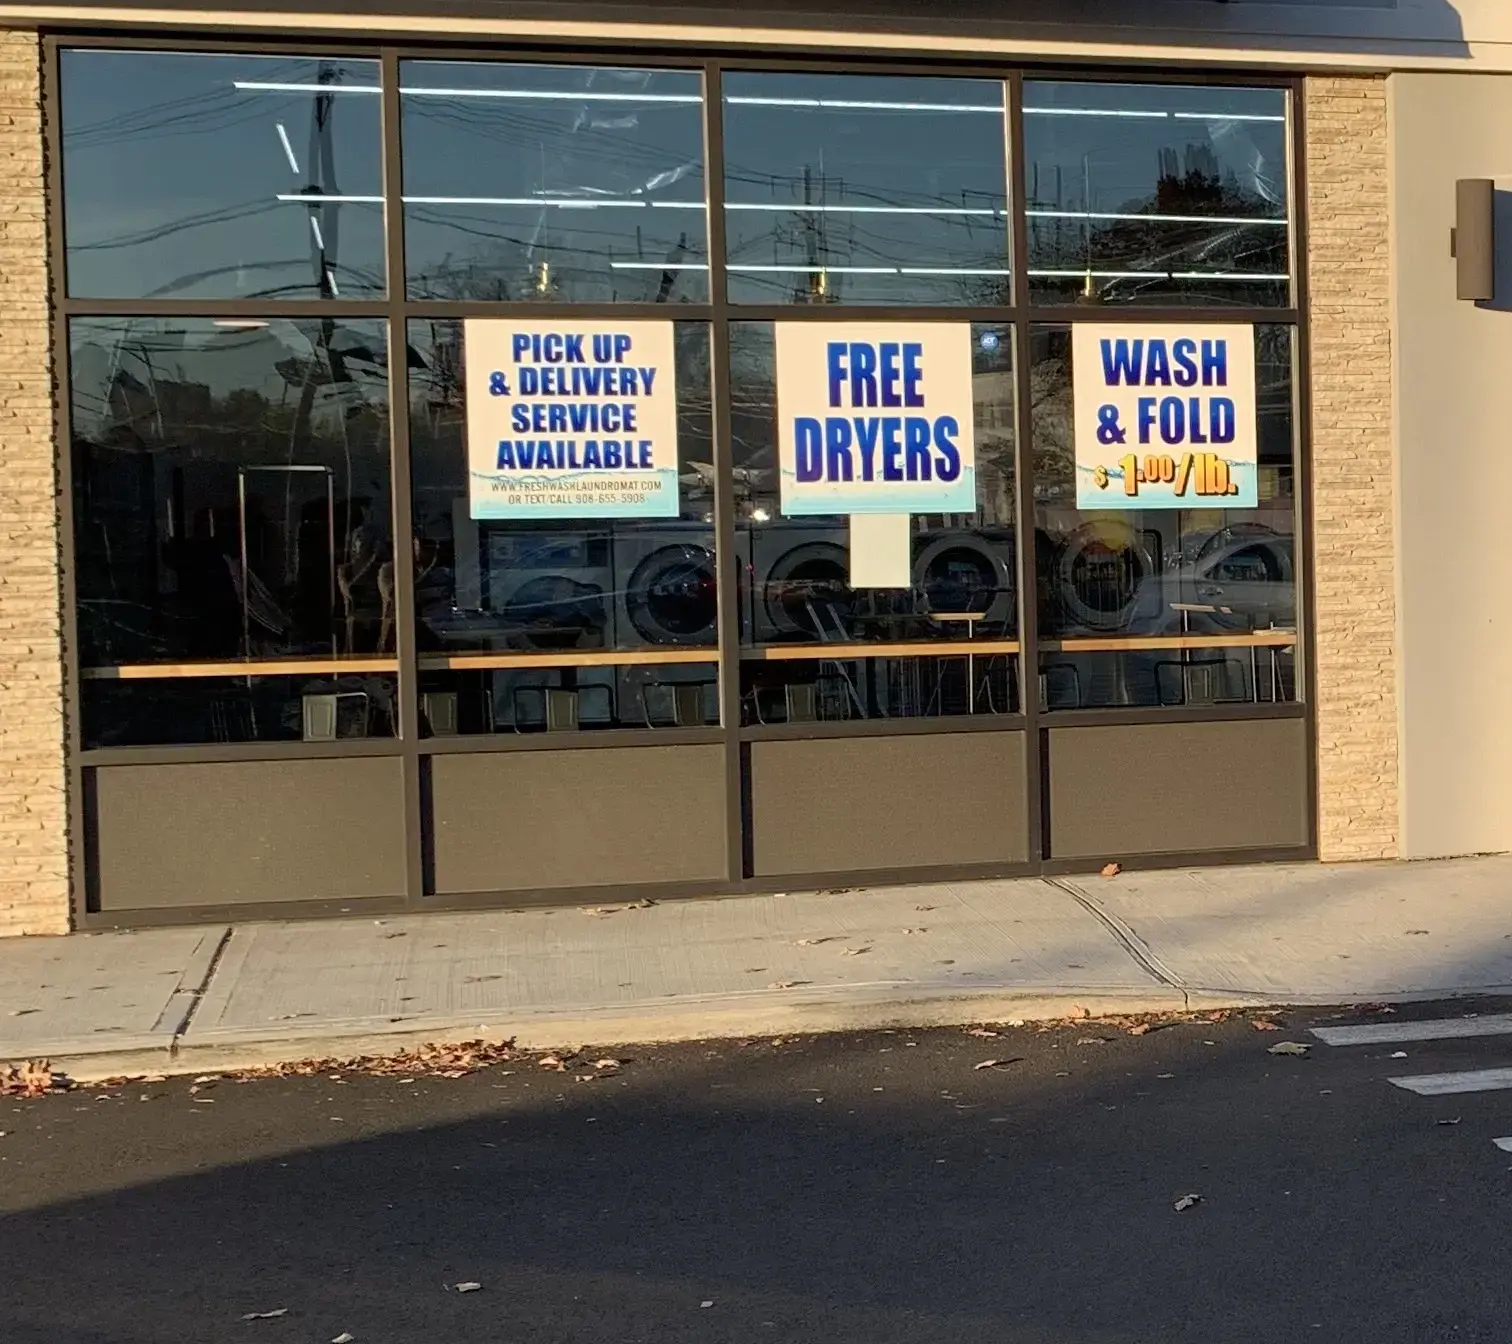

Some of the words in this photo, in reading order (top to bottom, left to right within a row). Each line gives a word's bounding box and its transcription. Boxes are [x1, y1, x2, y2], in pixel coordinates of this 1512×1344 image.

[512, 333, 585, 363] PICK
[593, 333, 632, 363] UP
[1100, 338, 1228, 387] WASH
[489, 371, 511, 396] &
[518, 367, 657, 396] DELIVERY
[827, 342, 925, 408] FREE
[511, 403, 638, 433] SERVICE
[1096, 404, 1126, 445] &
[1138, 396, 1235, 445] FOLD
[496, 440, 654, 470] AVAILABLE
[794, 415, 961, 483] DRYERS
[491, 481, 662, 492] WWW.FRESHWASHLAUNDROMAT.COM
[508, 494, 522, 505] OR
[575, 493, 646, 504] 908-655-5908
